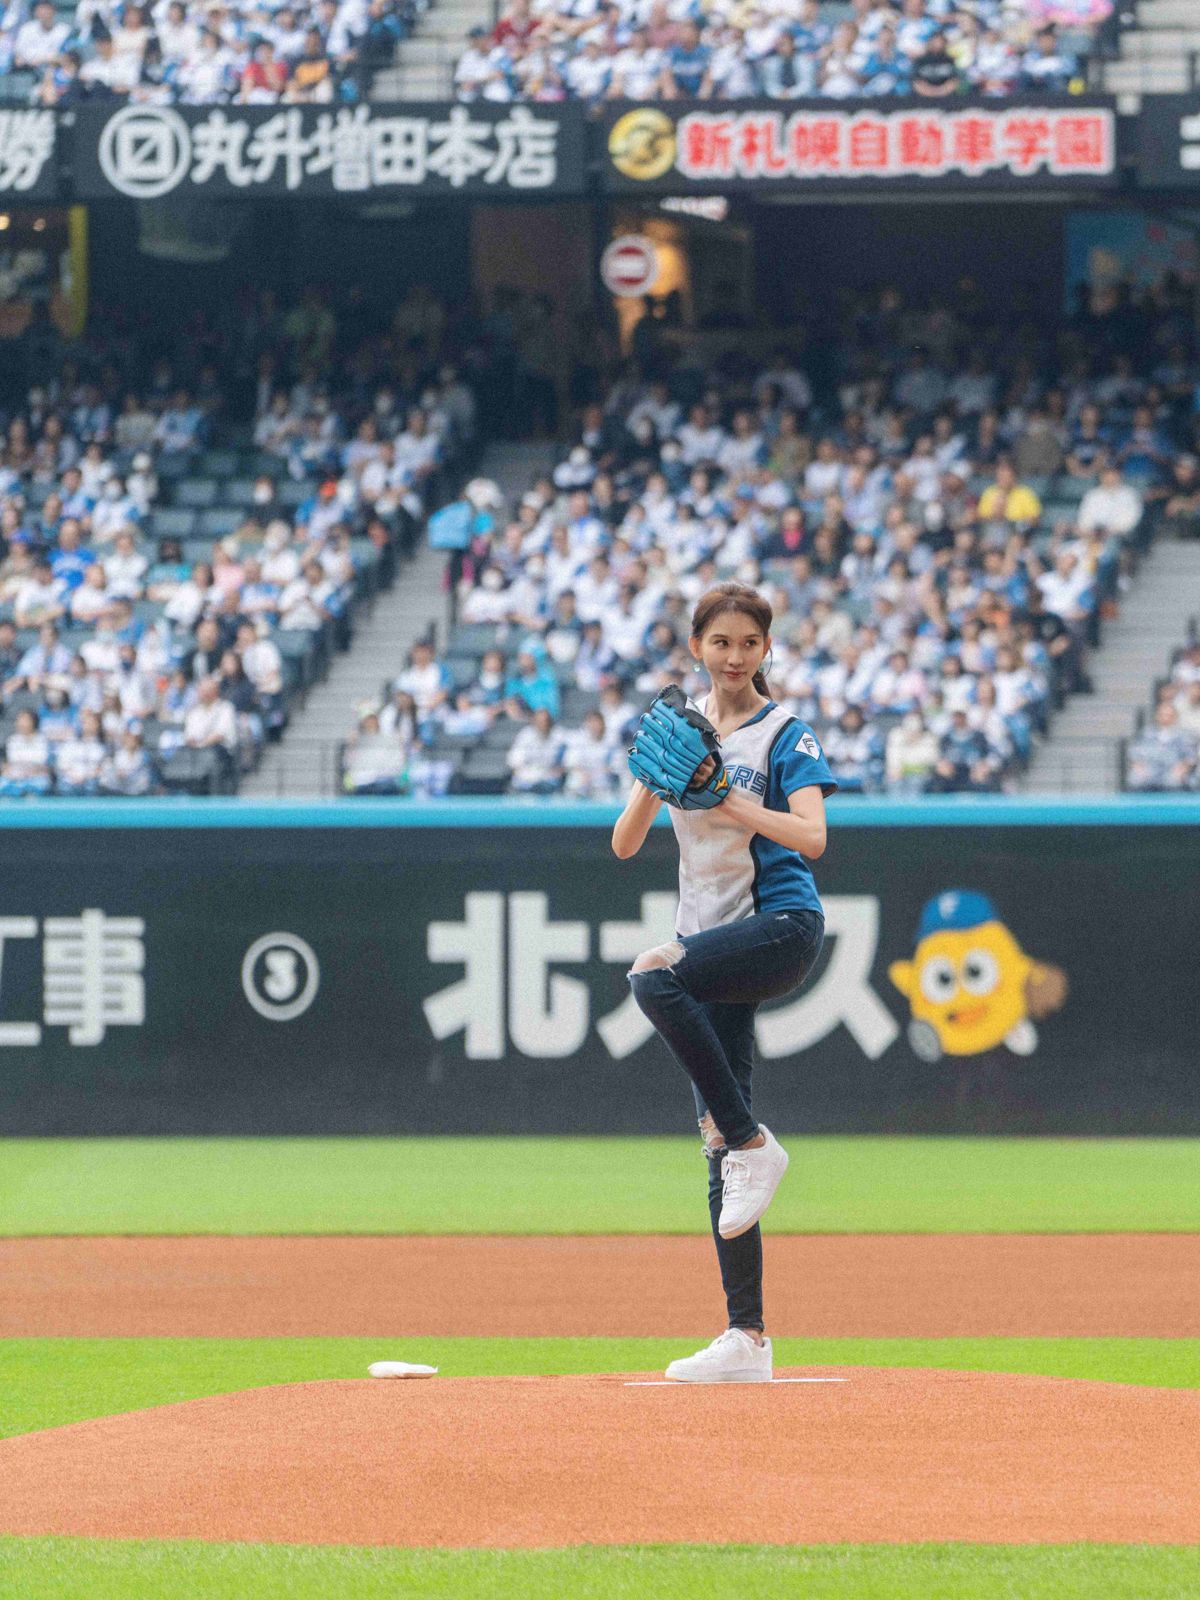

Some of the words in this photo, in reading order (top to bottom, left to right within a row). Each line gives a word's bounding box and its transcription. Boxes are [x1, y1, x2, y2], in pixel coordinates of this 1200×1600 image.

[190, 108, 558, 190] 丸升増田本店
[678, 110, 1113, 180] 新札幌自動車学園
